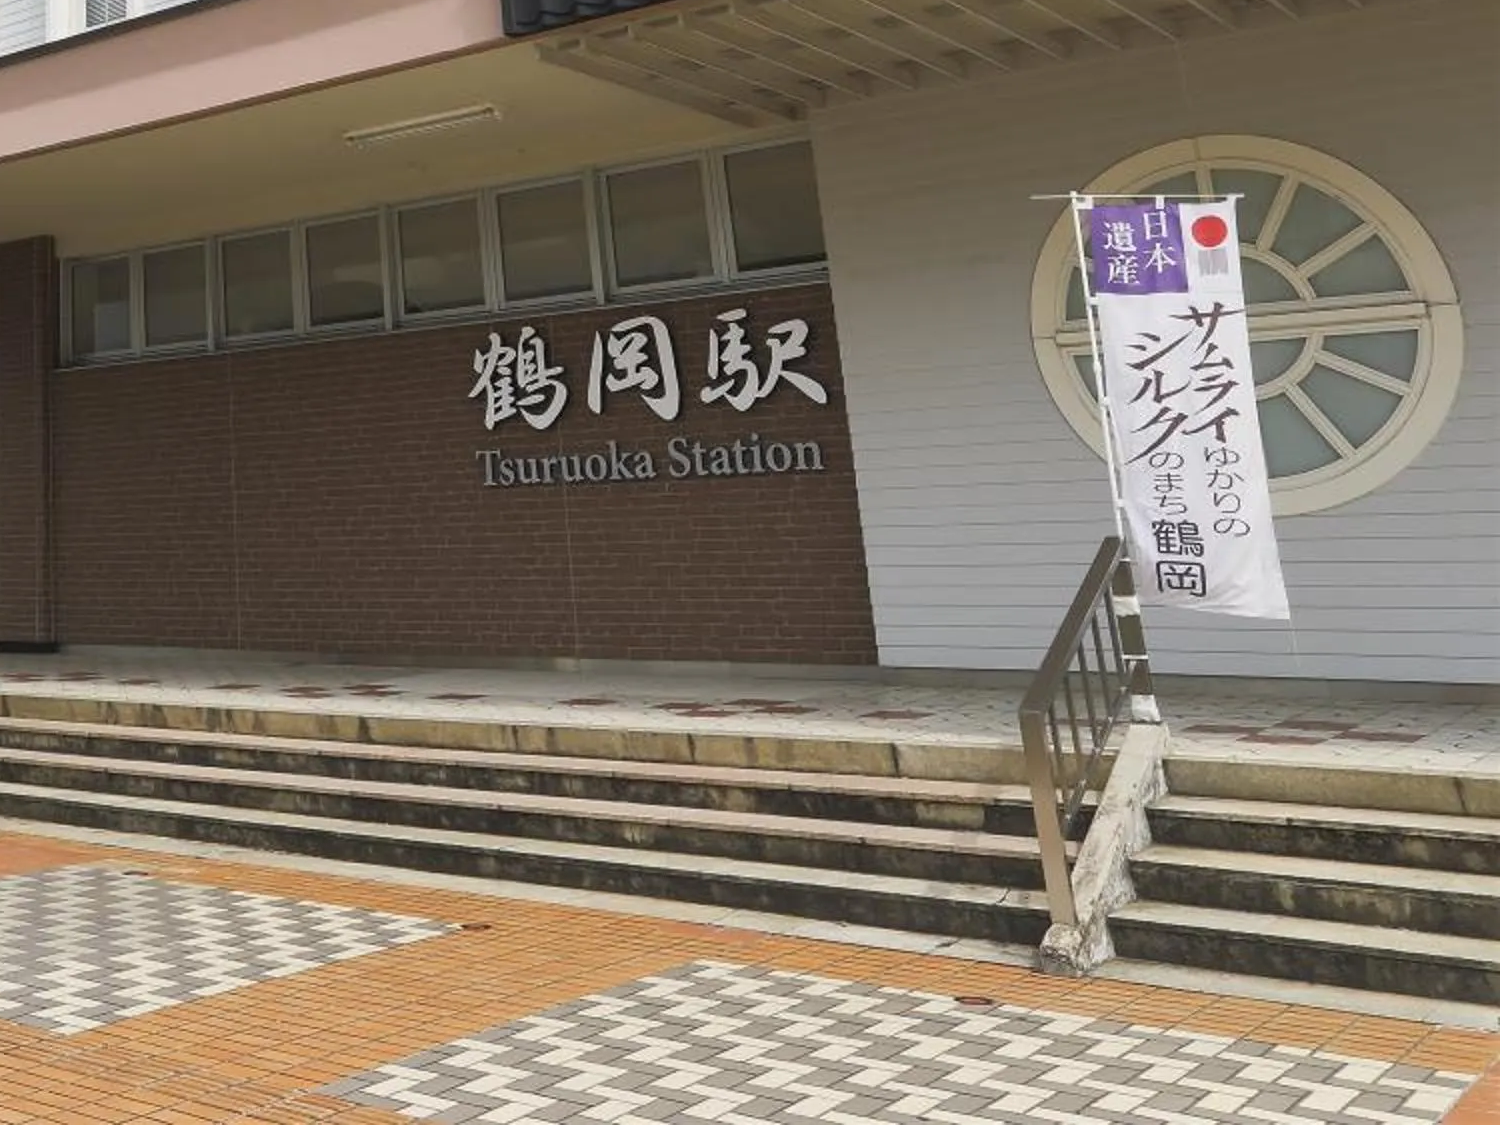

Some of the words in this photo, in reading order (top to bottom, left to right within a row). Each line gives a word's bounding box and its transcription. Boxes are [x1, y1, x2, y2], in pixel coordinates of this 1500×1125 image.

[1102, 221, 1141, 285] 遺産
[1142, 210, 1177, 275] 日本
[468, 308, 828, 430] 鶴岡駅
[475, 439, 657, 487] Tsuruoka
[667, 431, 825, 480] Station
[1124, 331, 1207, 598] シルクのまち鶴岡
[1170, 301, 1251, 538] サムライゆかりの
